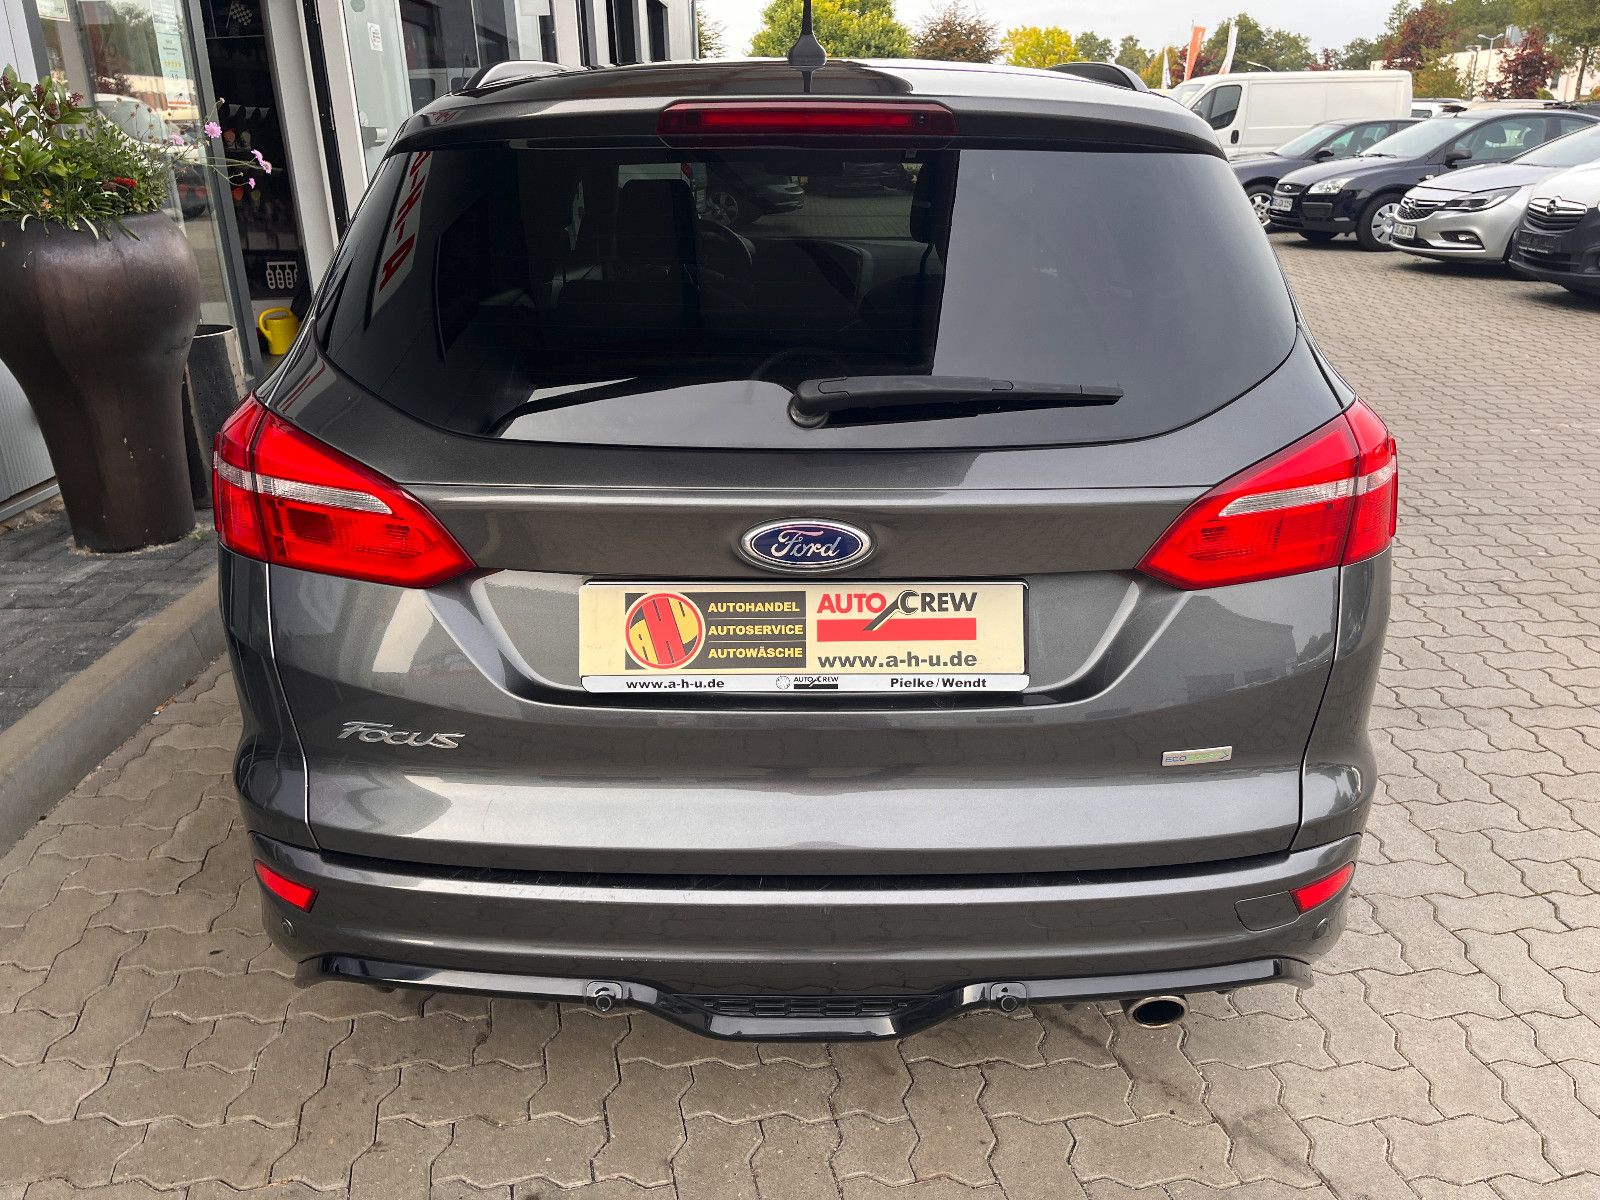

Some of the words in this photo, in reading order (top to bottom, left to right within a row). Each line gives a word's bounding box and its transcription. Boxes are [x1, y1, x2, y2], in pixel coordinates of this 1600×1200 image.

[770, 529, 842, 557] Ford
[707, 602, 801, 612] AUTOHANDEL
[707, 625, 804, 635] AUTOSERVICE
[707, 645, 803, 658] AUTOWÄSCHE
[817, 650, 978, 668] www.a-h-u.de
[625, 678, 725, 689] www.a-h-u.de
